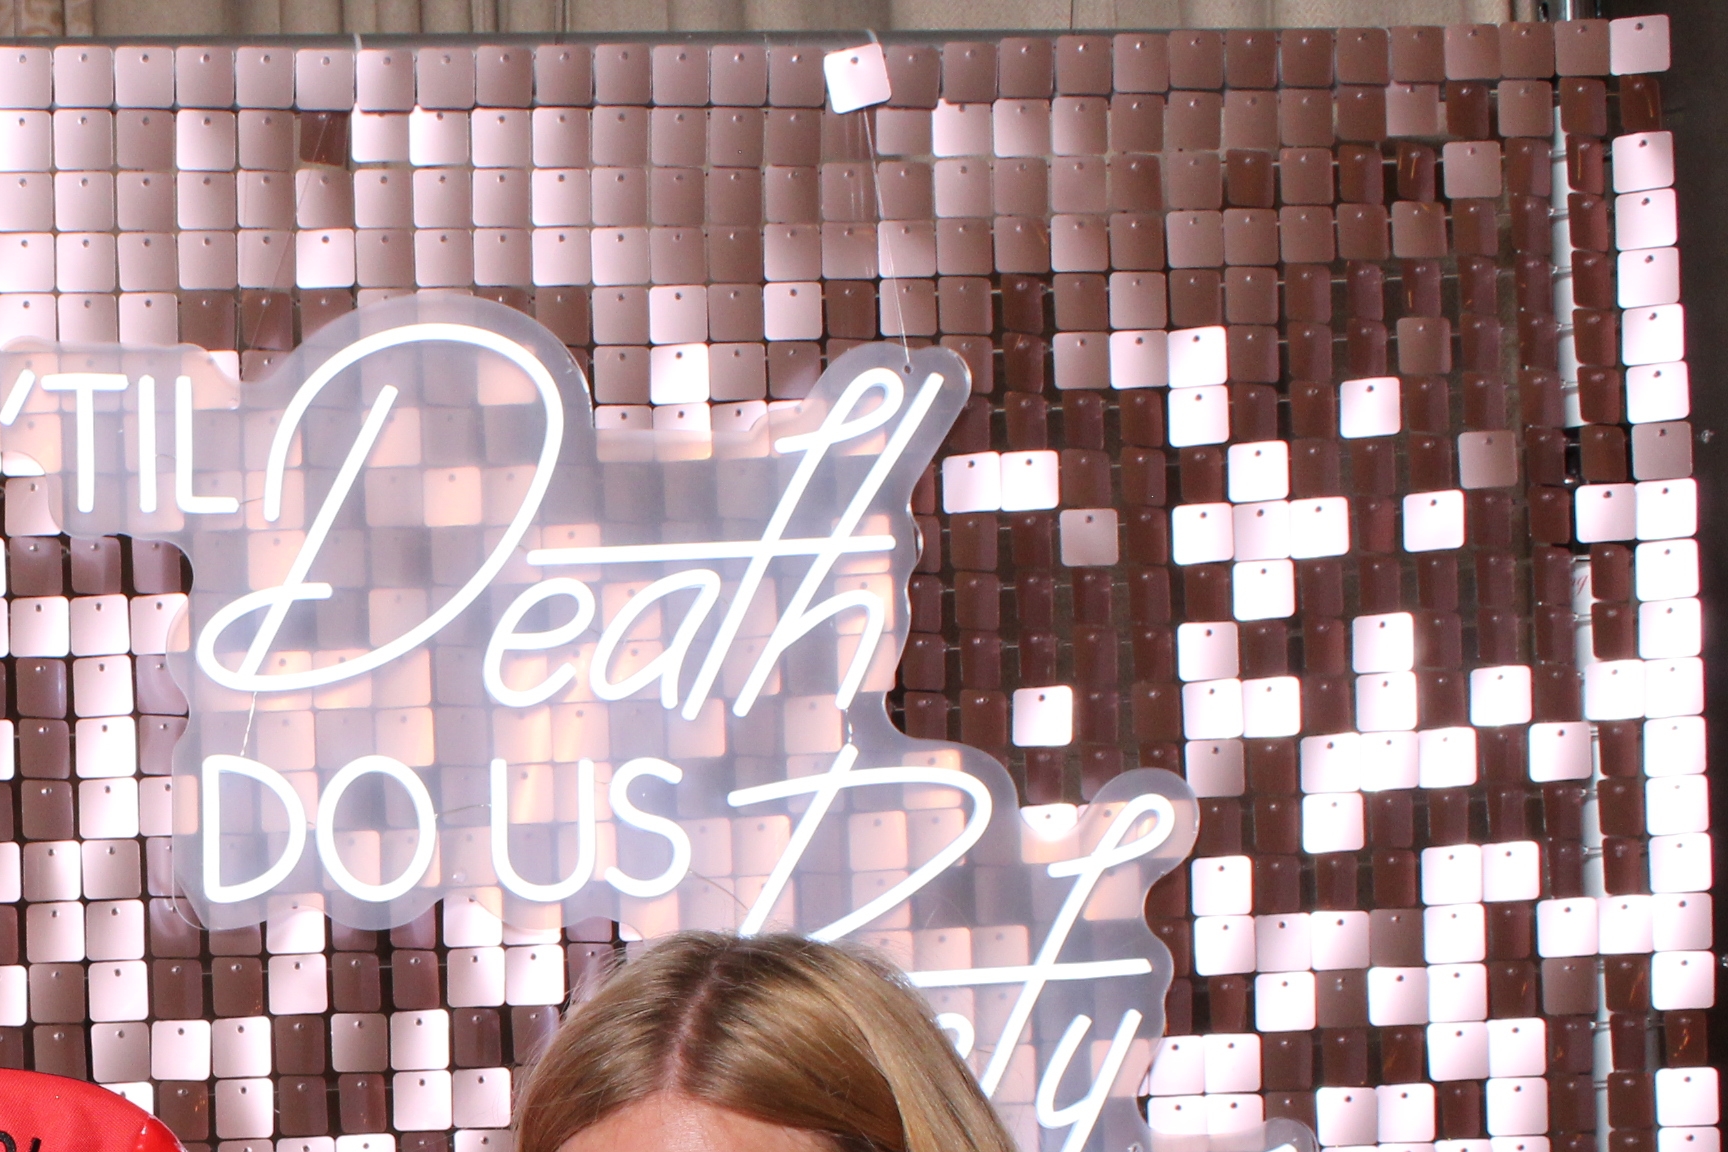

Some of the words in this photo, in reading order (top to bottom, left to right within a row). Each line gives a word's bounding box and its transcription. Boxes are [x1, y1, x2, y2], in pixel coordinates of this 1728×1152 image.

[1, 369, 239, 514] 'TIL
[195, 321, 946, 720] Death
[201, 752, 440, 905] DO
[489, 755, 693, 905] US
